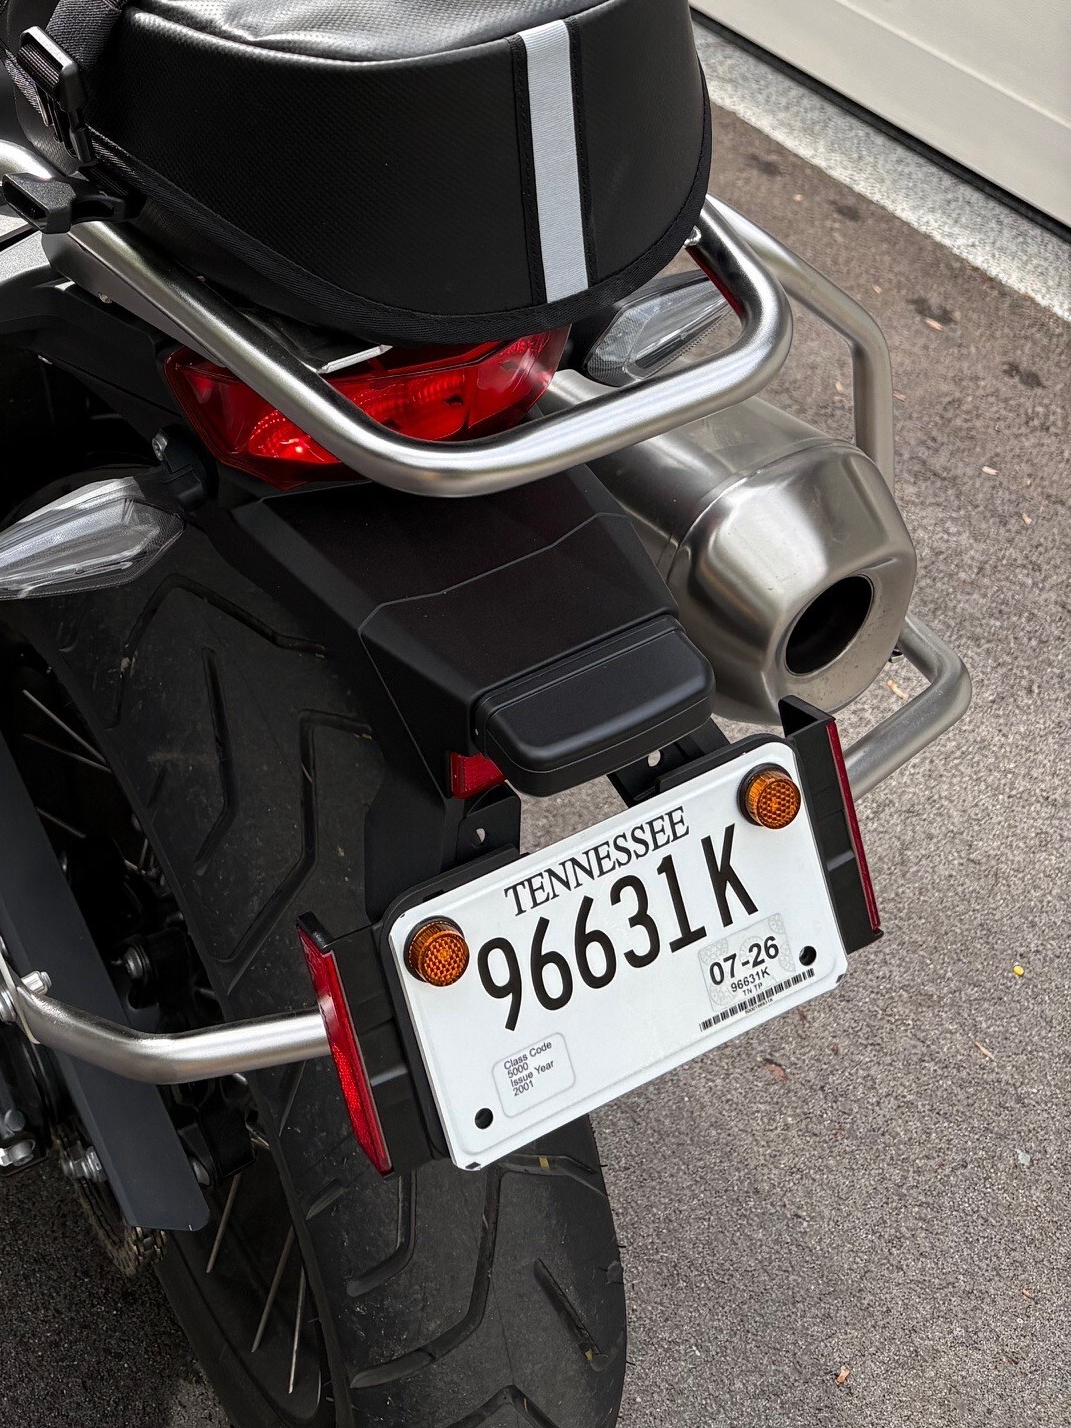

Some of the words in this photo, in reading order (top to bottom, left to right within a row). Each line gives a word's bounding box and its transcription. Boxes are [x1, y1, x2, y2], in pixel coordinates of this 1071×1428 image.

[504, 806, 691, 917] TENNESSEE
[477, 823, 759, 1032] 96631K
[709, 935, 779, 986] 07-26
[730, 966, 771, 993] 96631K
[503, 1053, 528, 1070] Class
[529, 1041, 552, 1058] Code
[507, 1062, 529, 1079] 5000
[510, 1071, 534, 1087] Issue
[533, 1060, 554, 1075] Year
[512, 1080, 534, 1097] 2001
